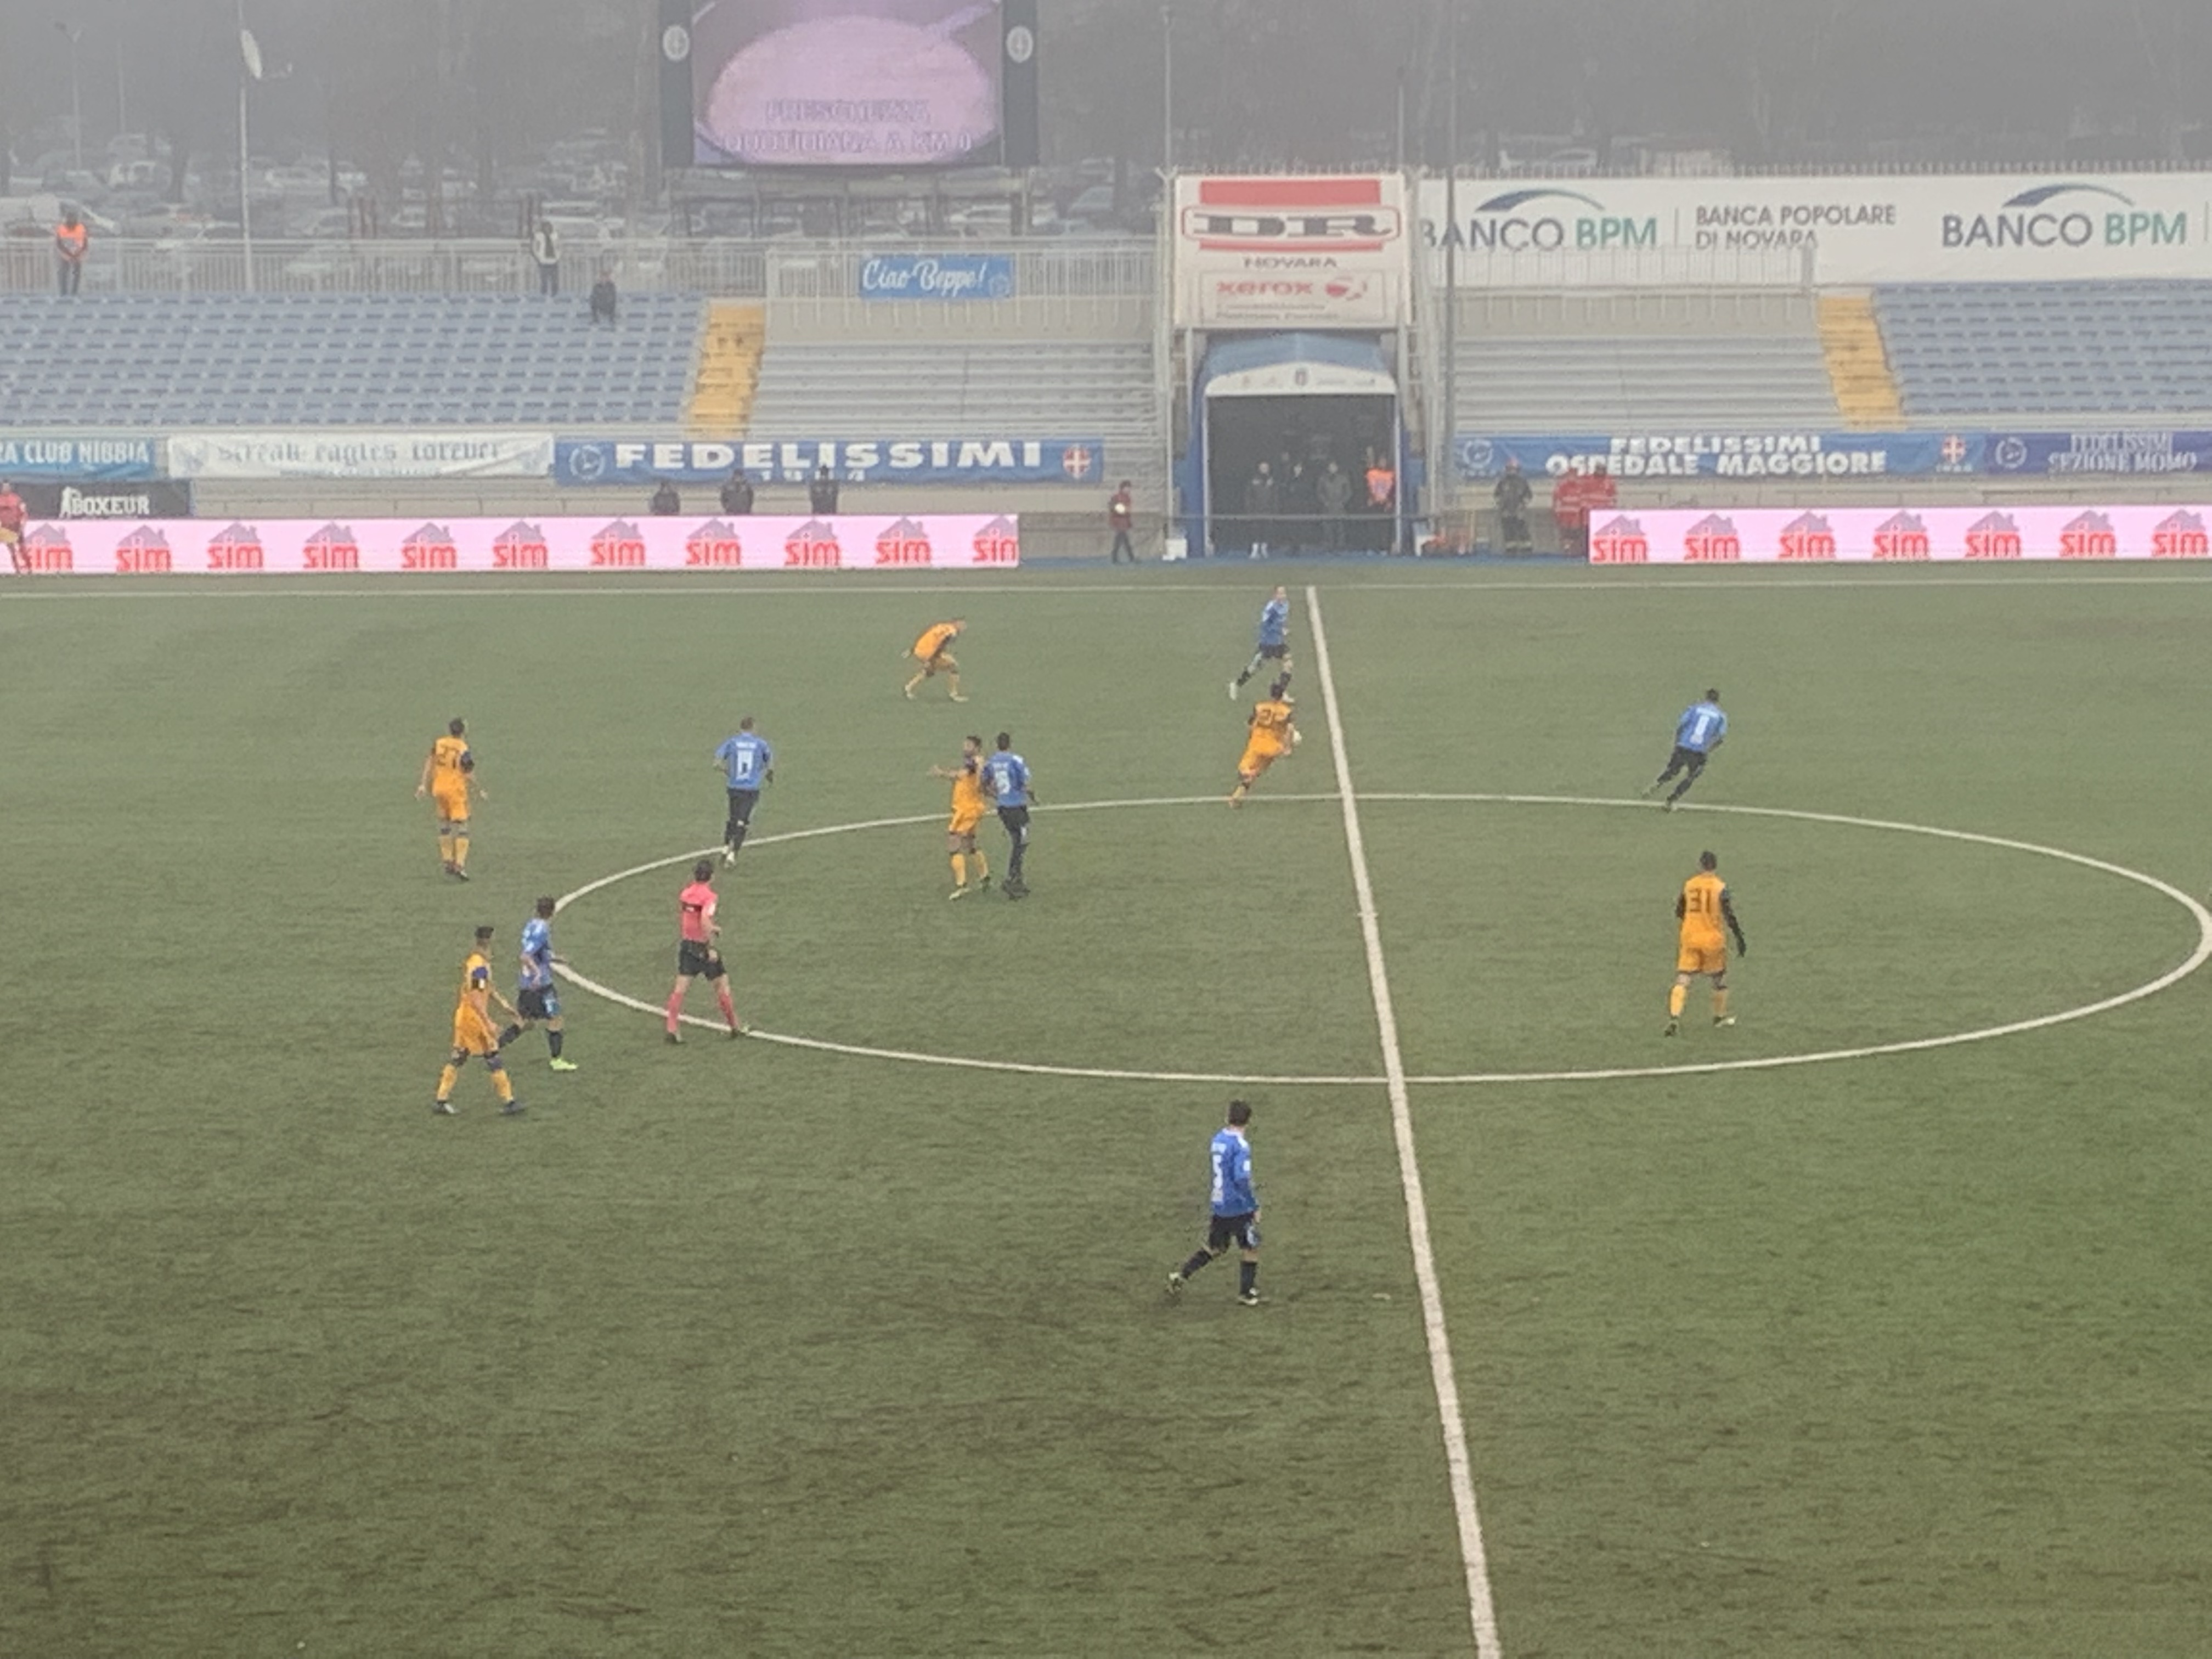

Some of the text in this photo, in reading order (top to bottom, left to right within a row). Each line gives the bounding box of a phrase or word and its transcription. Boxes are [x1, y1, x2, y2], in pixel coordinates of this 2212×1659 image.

[1696, 205, 1897, 225] BANCA POPOLARE
[1576, 217, 1657, 249] BPM
[1696, 230, 1818, 250] DI NOVARA
[1942, 212, 2188, 247] BANCO BPM
[862, 258, 911, 291] Ciao
[1244, 257, 1338, 269] NOVARA
[1216, 281, 1313, 296] xerox
[24, 441, 72, 464] CLUB
[77, 441, 149, 464] NIBBIA
[616, 442, 1041, 469] FEDELISSIMI
[1610, 436, 1820, 454] FEDELISSIMI
[1545, 450, 1886, 476] OSPEDALE MAGGIORE
[493, 543, 548, 567] sim
[591, 540, 645, 565] sim
[686, 540, 740, 565] sim
[785, 541, 840, 565] sim
[876, 539, 930, 563] sim
[1592, 537, 1647, 562] sim
[1684, 535, 1739, 560] sim
[1779, 533, 1834, 558] sim
[1873, 532, 1928, 556] sim
[1965, 532, 2021, 556] sim
[2059, 532, 2115, 556] sim
[2152, 531, 2208, 556] sim
[116, 548, 171, 572] sim
[207, 544, 263, 568] sim
[303, 544, 358, 568] sim
[402, 545, 456, 569] sim
[1688, 888, 1712, 913] 31
